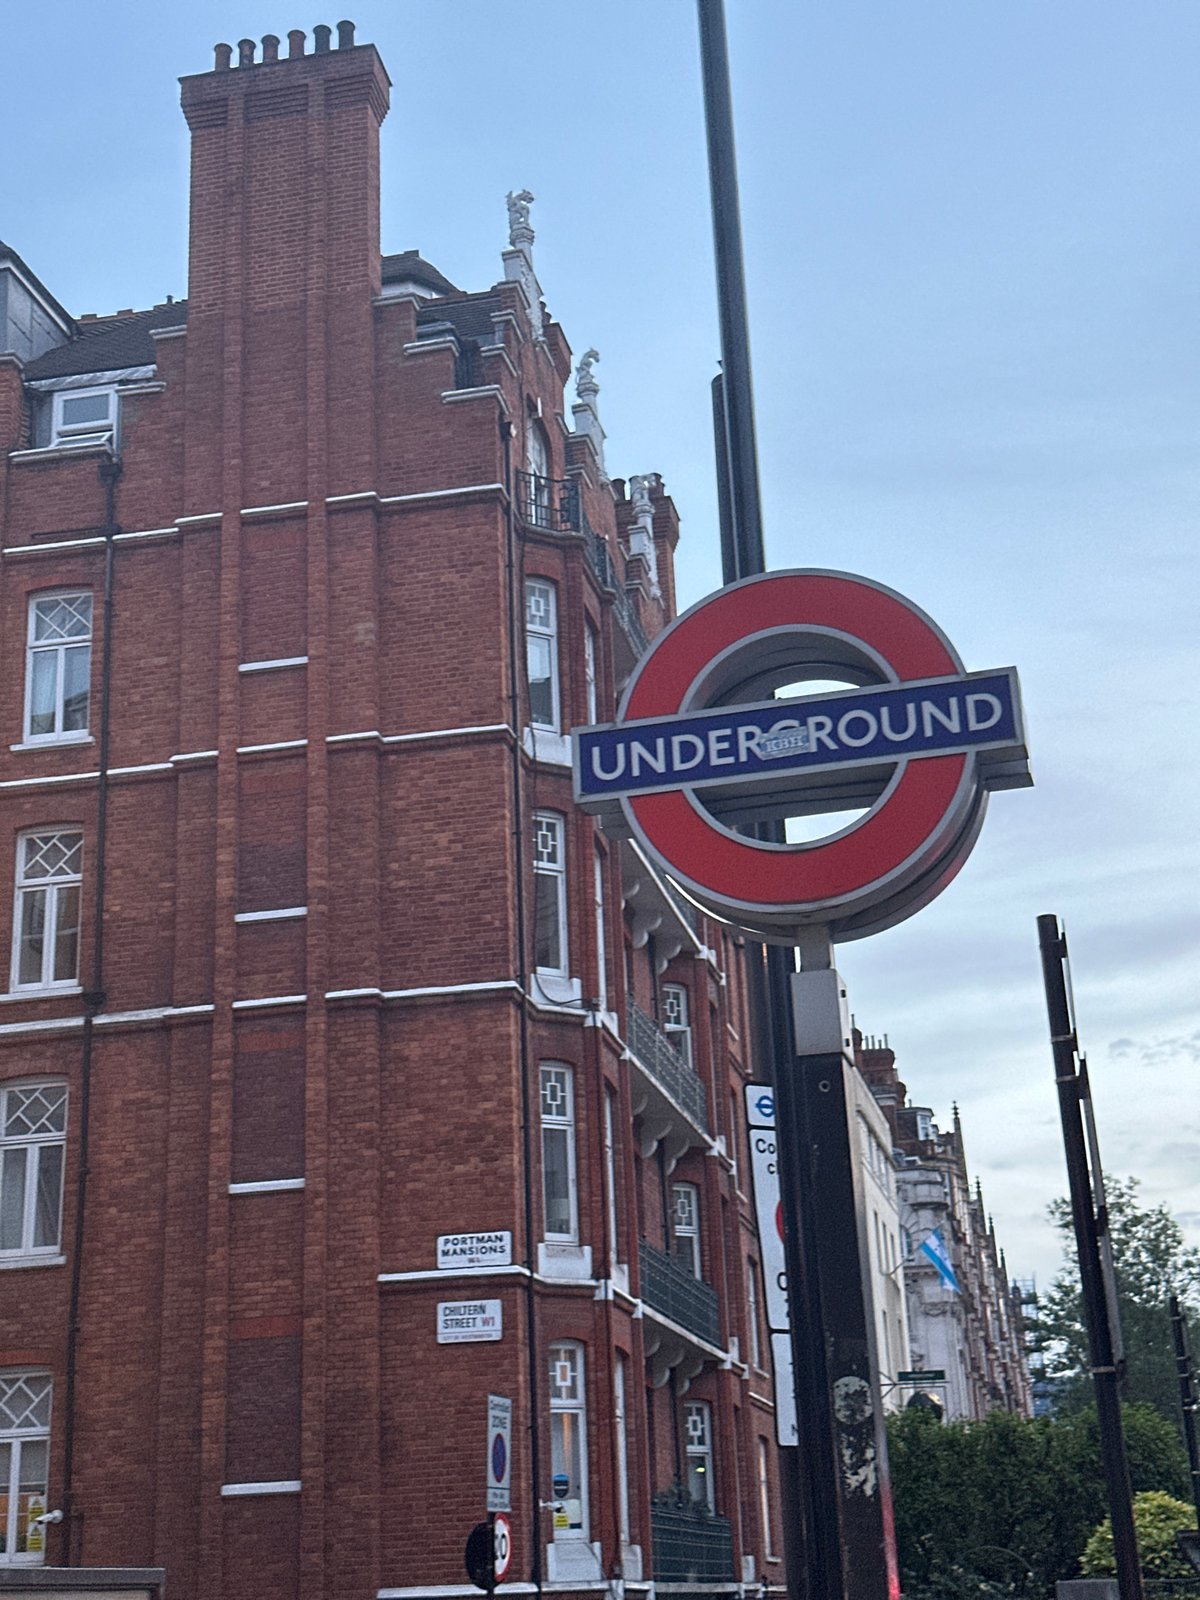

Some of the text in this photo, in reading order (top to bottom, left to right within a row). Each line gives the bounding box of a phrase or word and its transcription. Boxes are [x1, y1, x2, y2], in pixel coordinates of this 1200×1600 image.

[443, 1234, 503, 1247] PORTMAN
[441, 1245, 506, 1257] MANSIONS
[443, 1303, 486, 1317] CHILTERN
[443, 1316, 495, 1329] STREET W1
